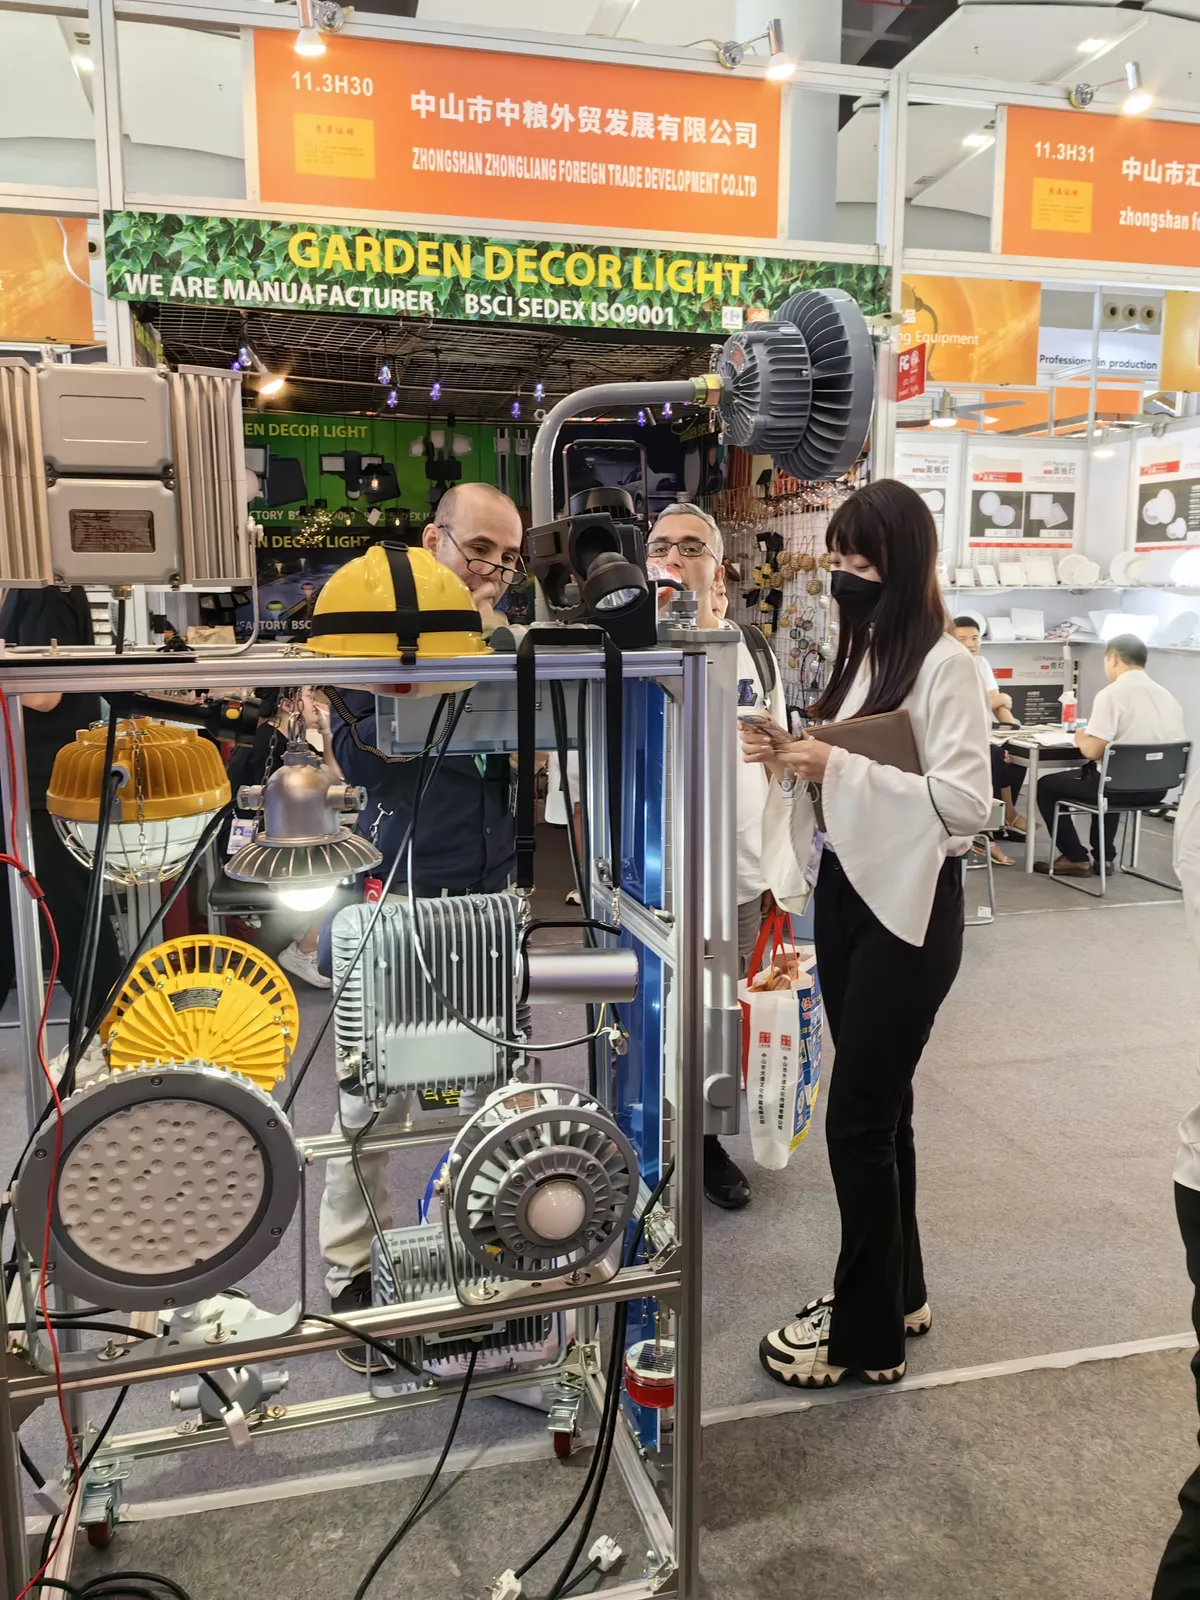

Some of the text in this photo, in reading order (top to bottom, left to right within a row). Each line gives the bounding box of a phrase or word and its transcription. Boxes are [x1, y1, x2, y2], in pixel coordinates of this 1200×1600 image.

[292, 70, 374, 97] 11.3H30
[410, 89, 757, 149] 中山市中粮外贸发展有限公司
[1034, 140, 1095, 163] 11.3H31
[412, 147, 757, 198] ZHONGSHAN ZHONGLIANG FOREIGN TRADE DEVELOPMENT CO.LTD
[1118, 205, 1189, 233] zhongshan
[287, 231, 748, 297] GARDEN DECOR LIGHT
[124, 272, 675, 326] WE ARE MANUAFACTURER BSCI SEDEX ISO9001
[915, 330, 980, 347] Equipment
[1096, 358, 1106, 367] in
[1108, 357, 1158, 370] production
[268, 423, 319, 437] DECOR
[323, 424, 369, 438] LIGHT
[291, 620, 312, 630] BSC
